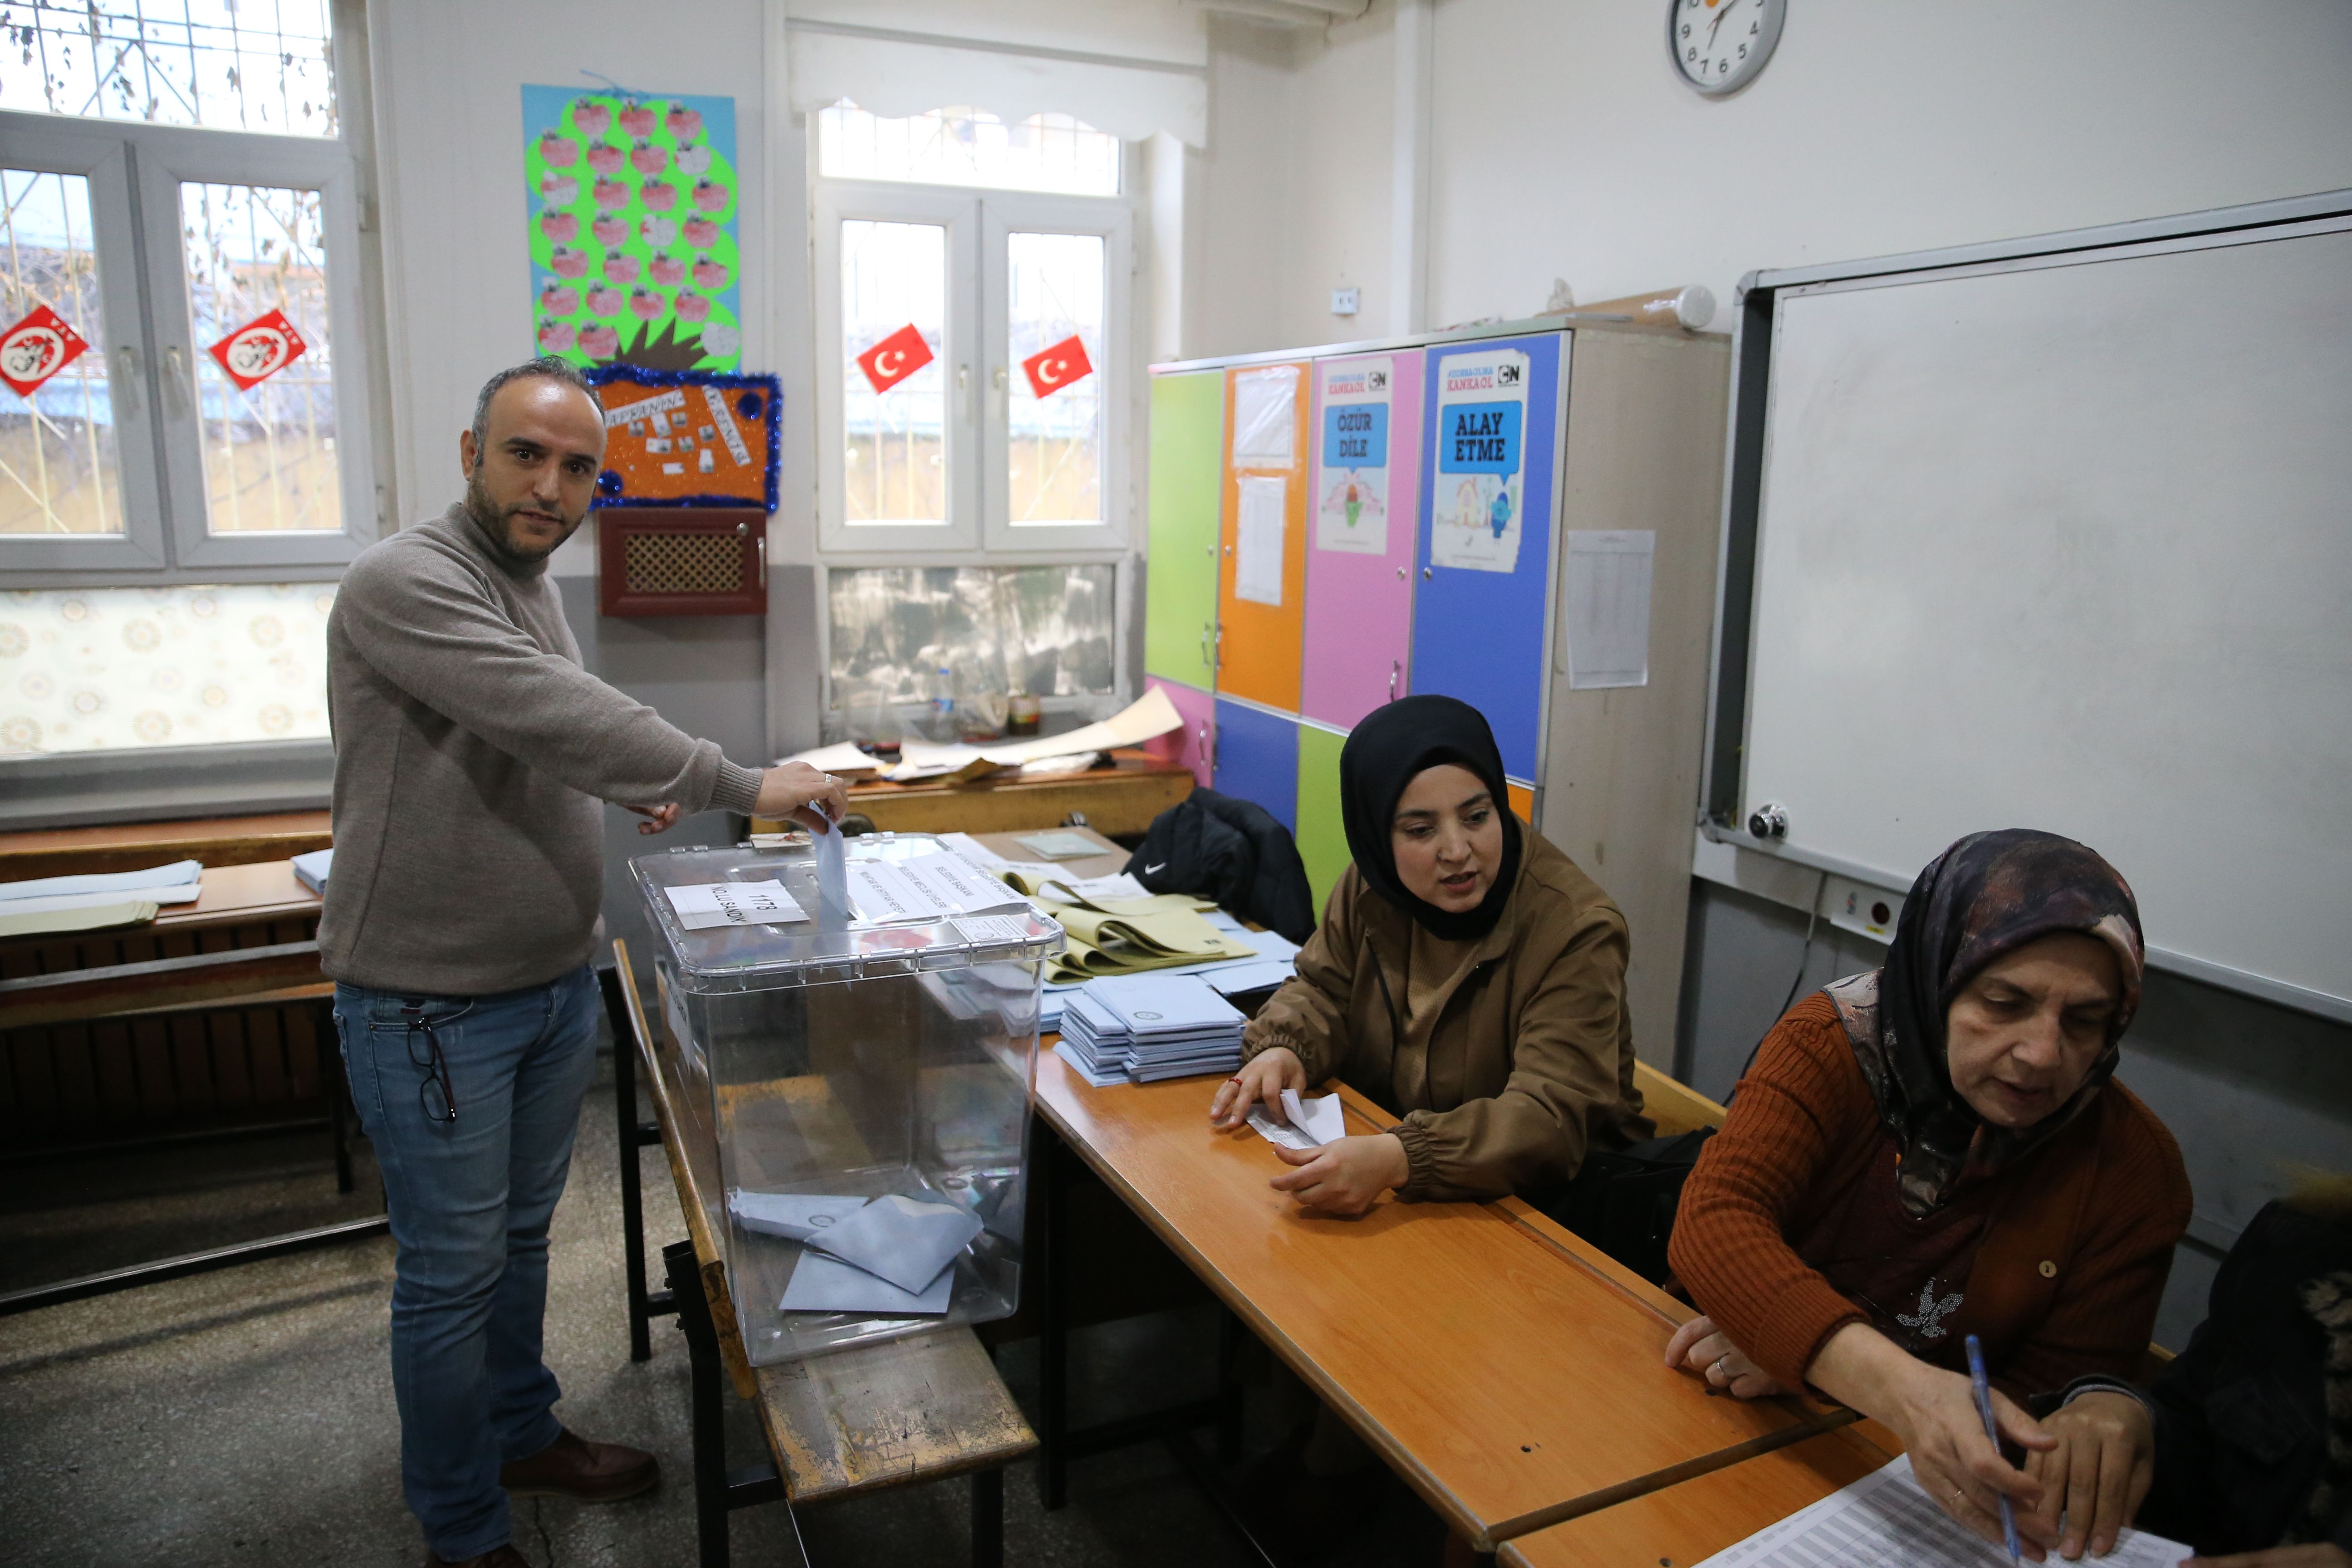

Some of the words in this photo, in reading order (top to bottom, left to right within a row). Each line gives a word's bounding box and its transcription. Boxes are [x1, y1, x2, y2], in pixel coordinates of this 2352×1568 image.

[1681, 24, 1690, 39] 9
[1749, 20, 1758, 35] 4
[1688, 47, 1696, 61] 8
[1738, 43, 1746, 59] 5
[1700, 58, 1709, 74] 7
[1719, 58, 1728, 73] 6
[1498, 365, 1519, 383] CN
[1337, 408, 1372, 432] ÖZÜR
[1455, 412, 1504, 436] ALAY
[1338, 436, 1368, 458] DİLE
[1455, 438, 1505, 461] ETME
[749, 894, 778, 910] 1178
[720, 902, 747, 923] SANDIK
